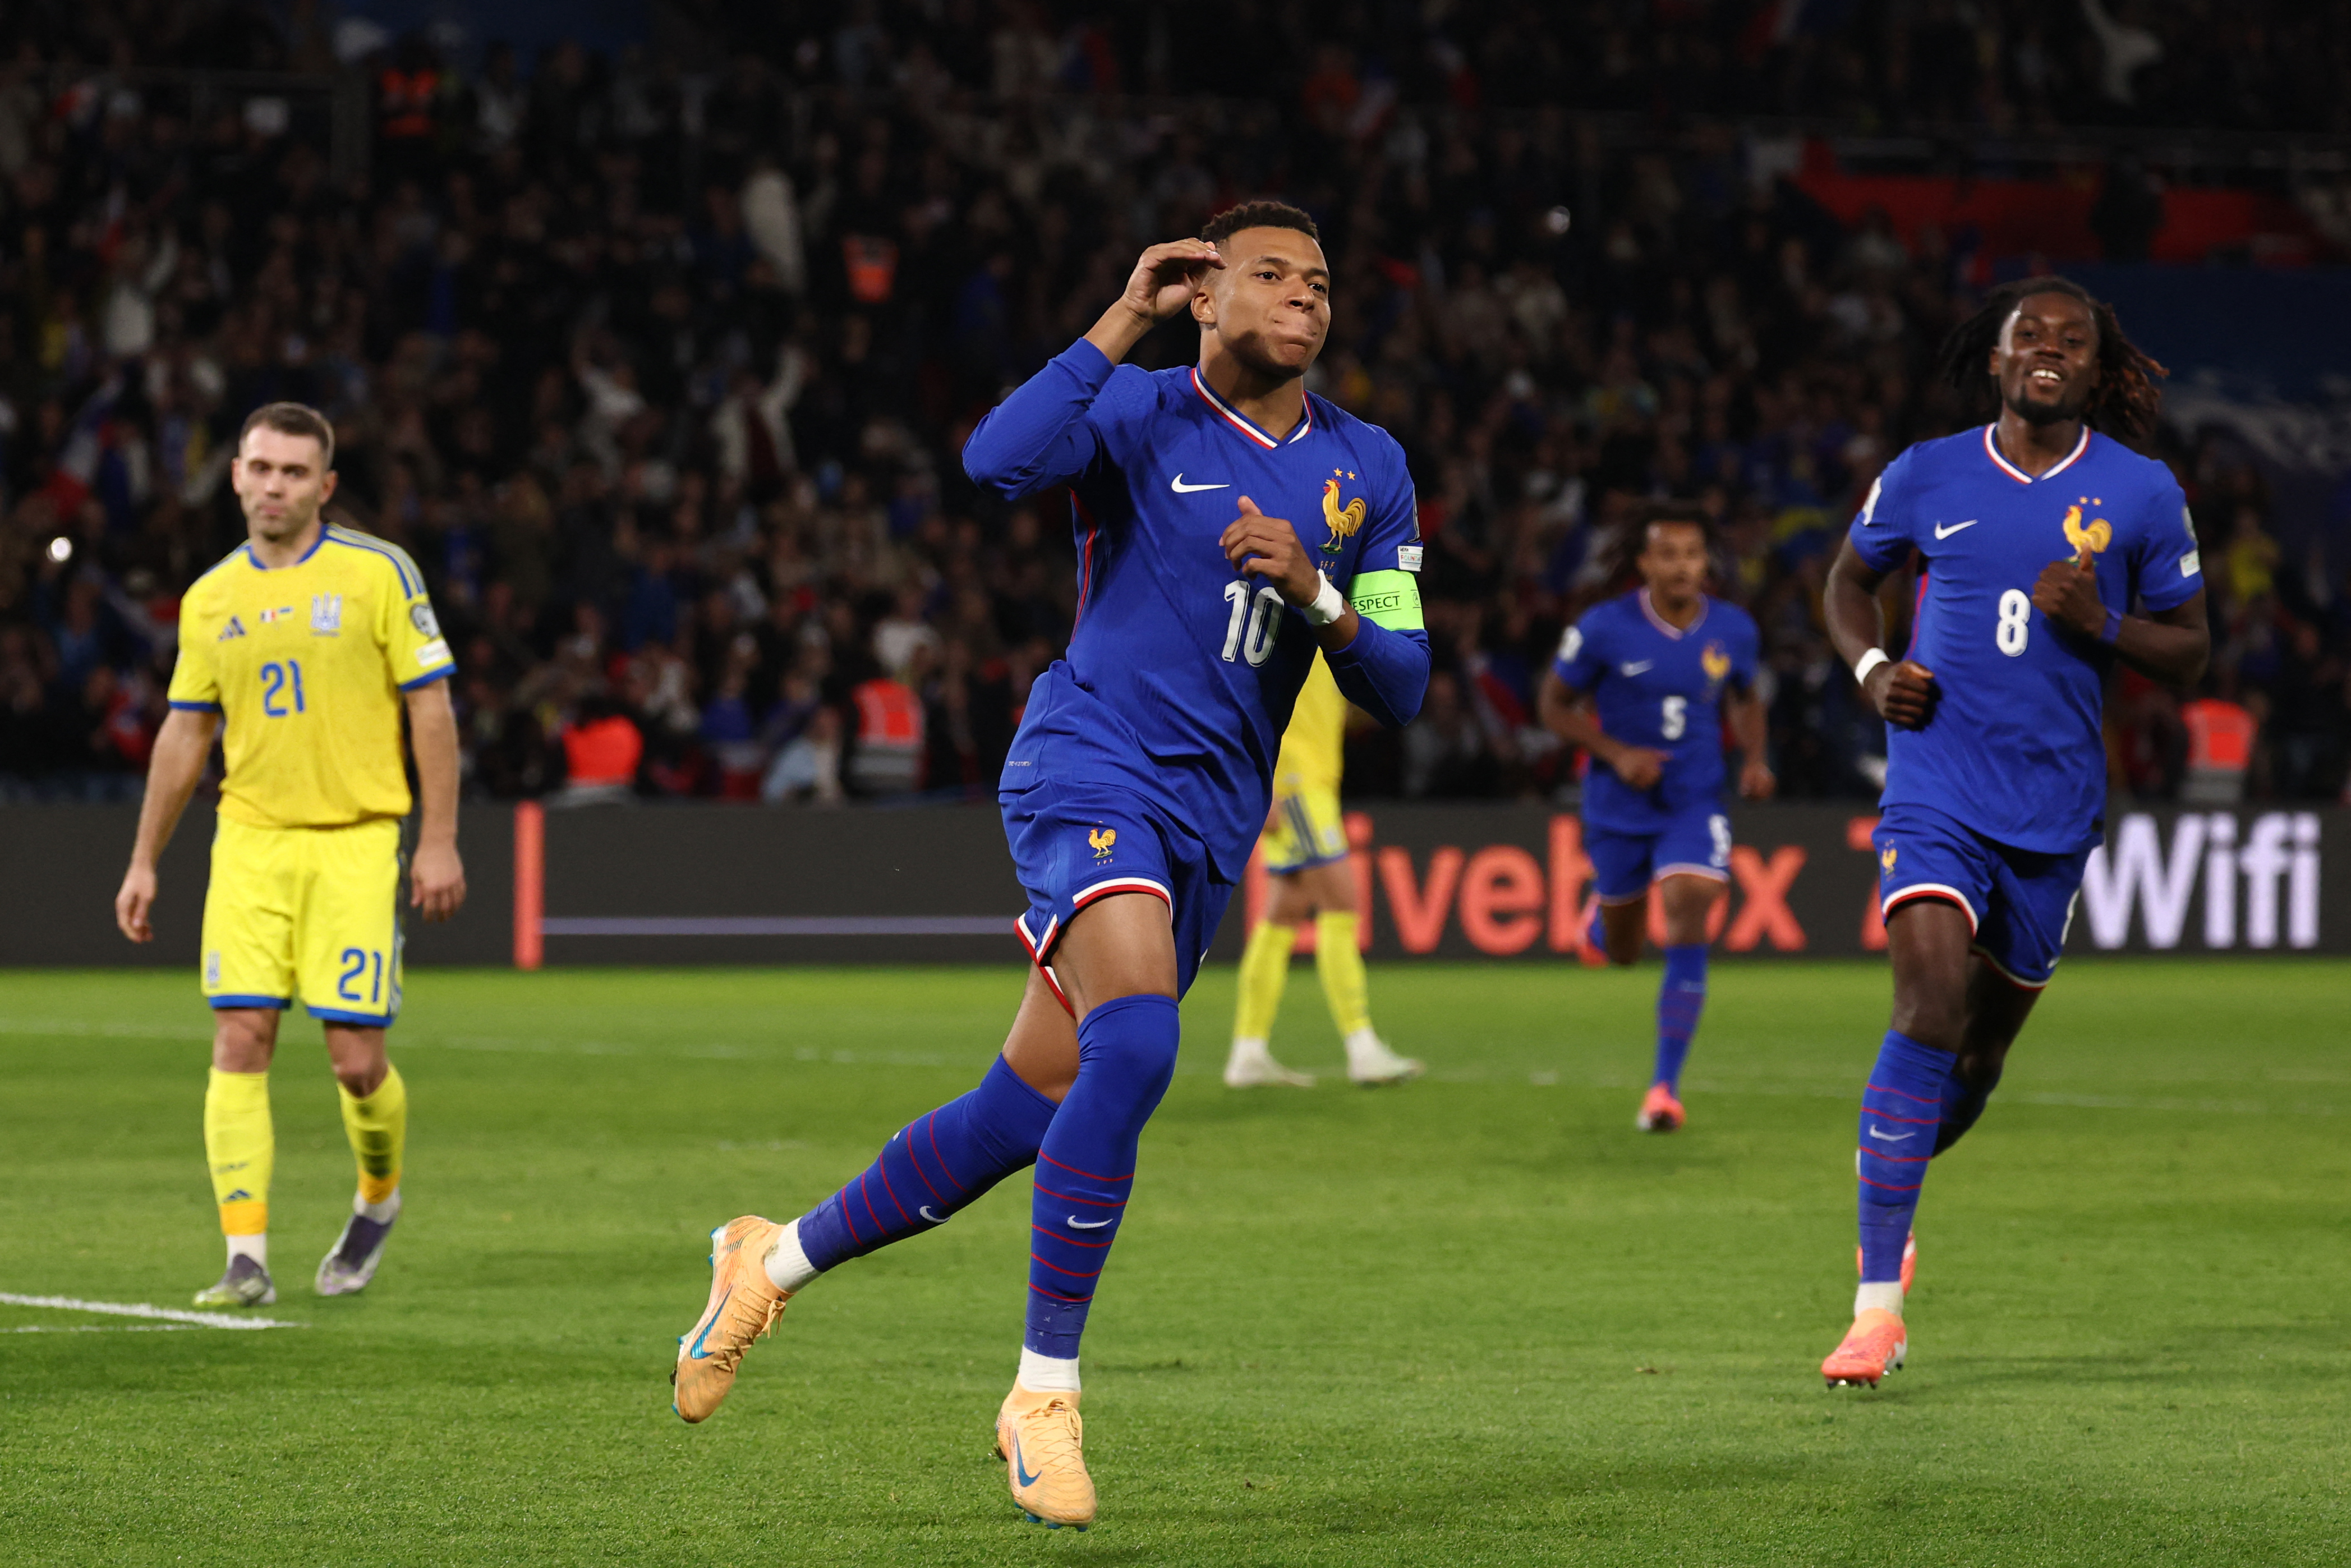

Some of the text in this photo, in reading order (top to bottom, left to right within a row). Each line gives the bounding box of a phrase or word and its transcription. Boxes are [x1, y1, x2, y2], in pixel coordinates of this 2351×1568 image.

[1222, 580, 1285, 668] 10
[1352, 595, 1400, 611] ESPECT
[1996, 588, 2031, 657] 8
[260, 659, 305, 716] 21
[1662, 695, 1687, 740] 5
[2082, 811, 2322, 949] Wifi
[338, 947, 382, 1003] 21
